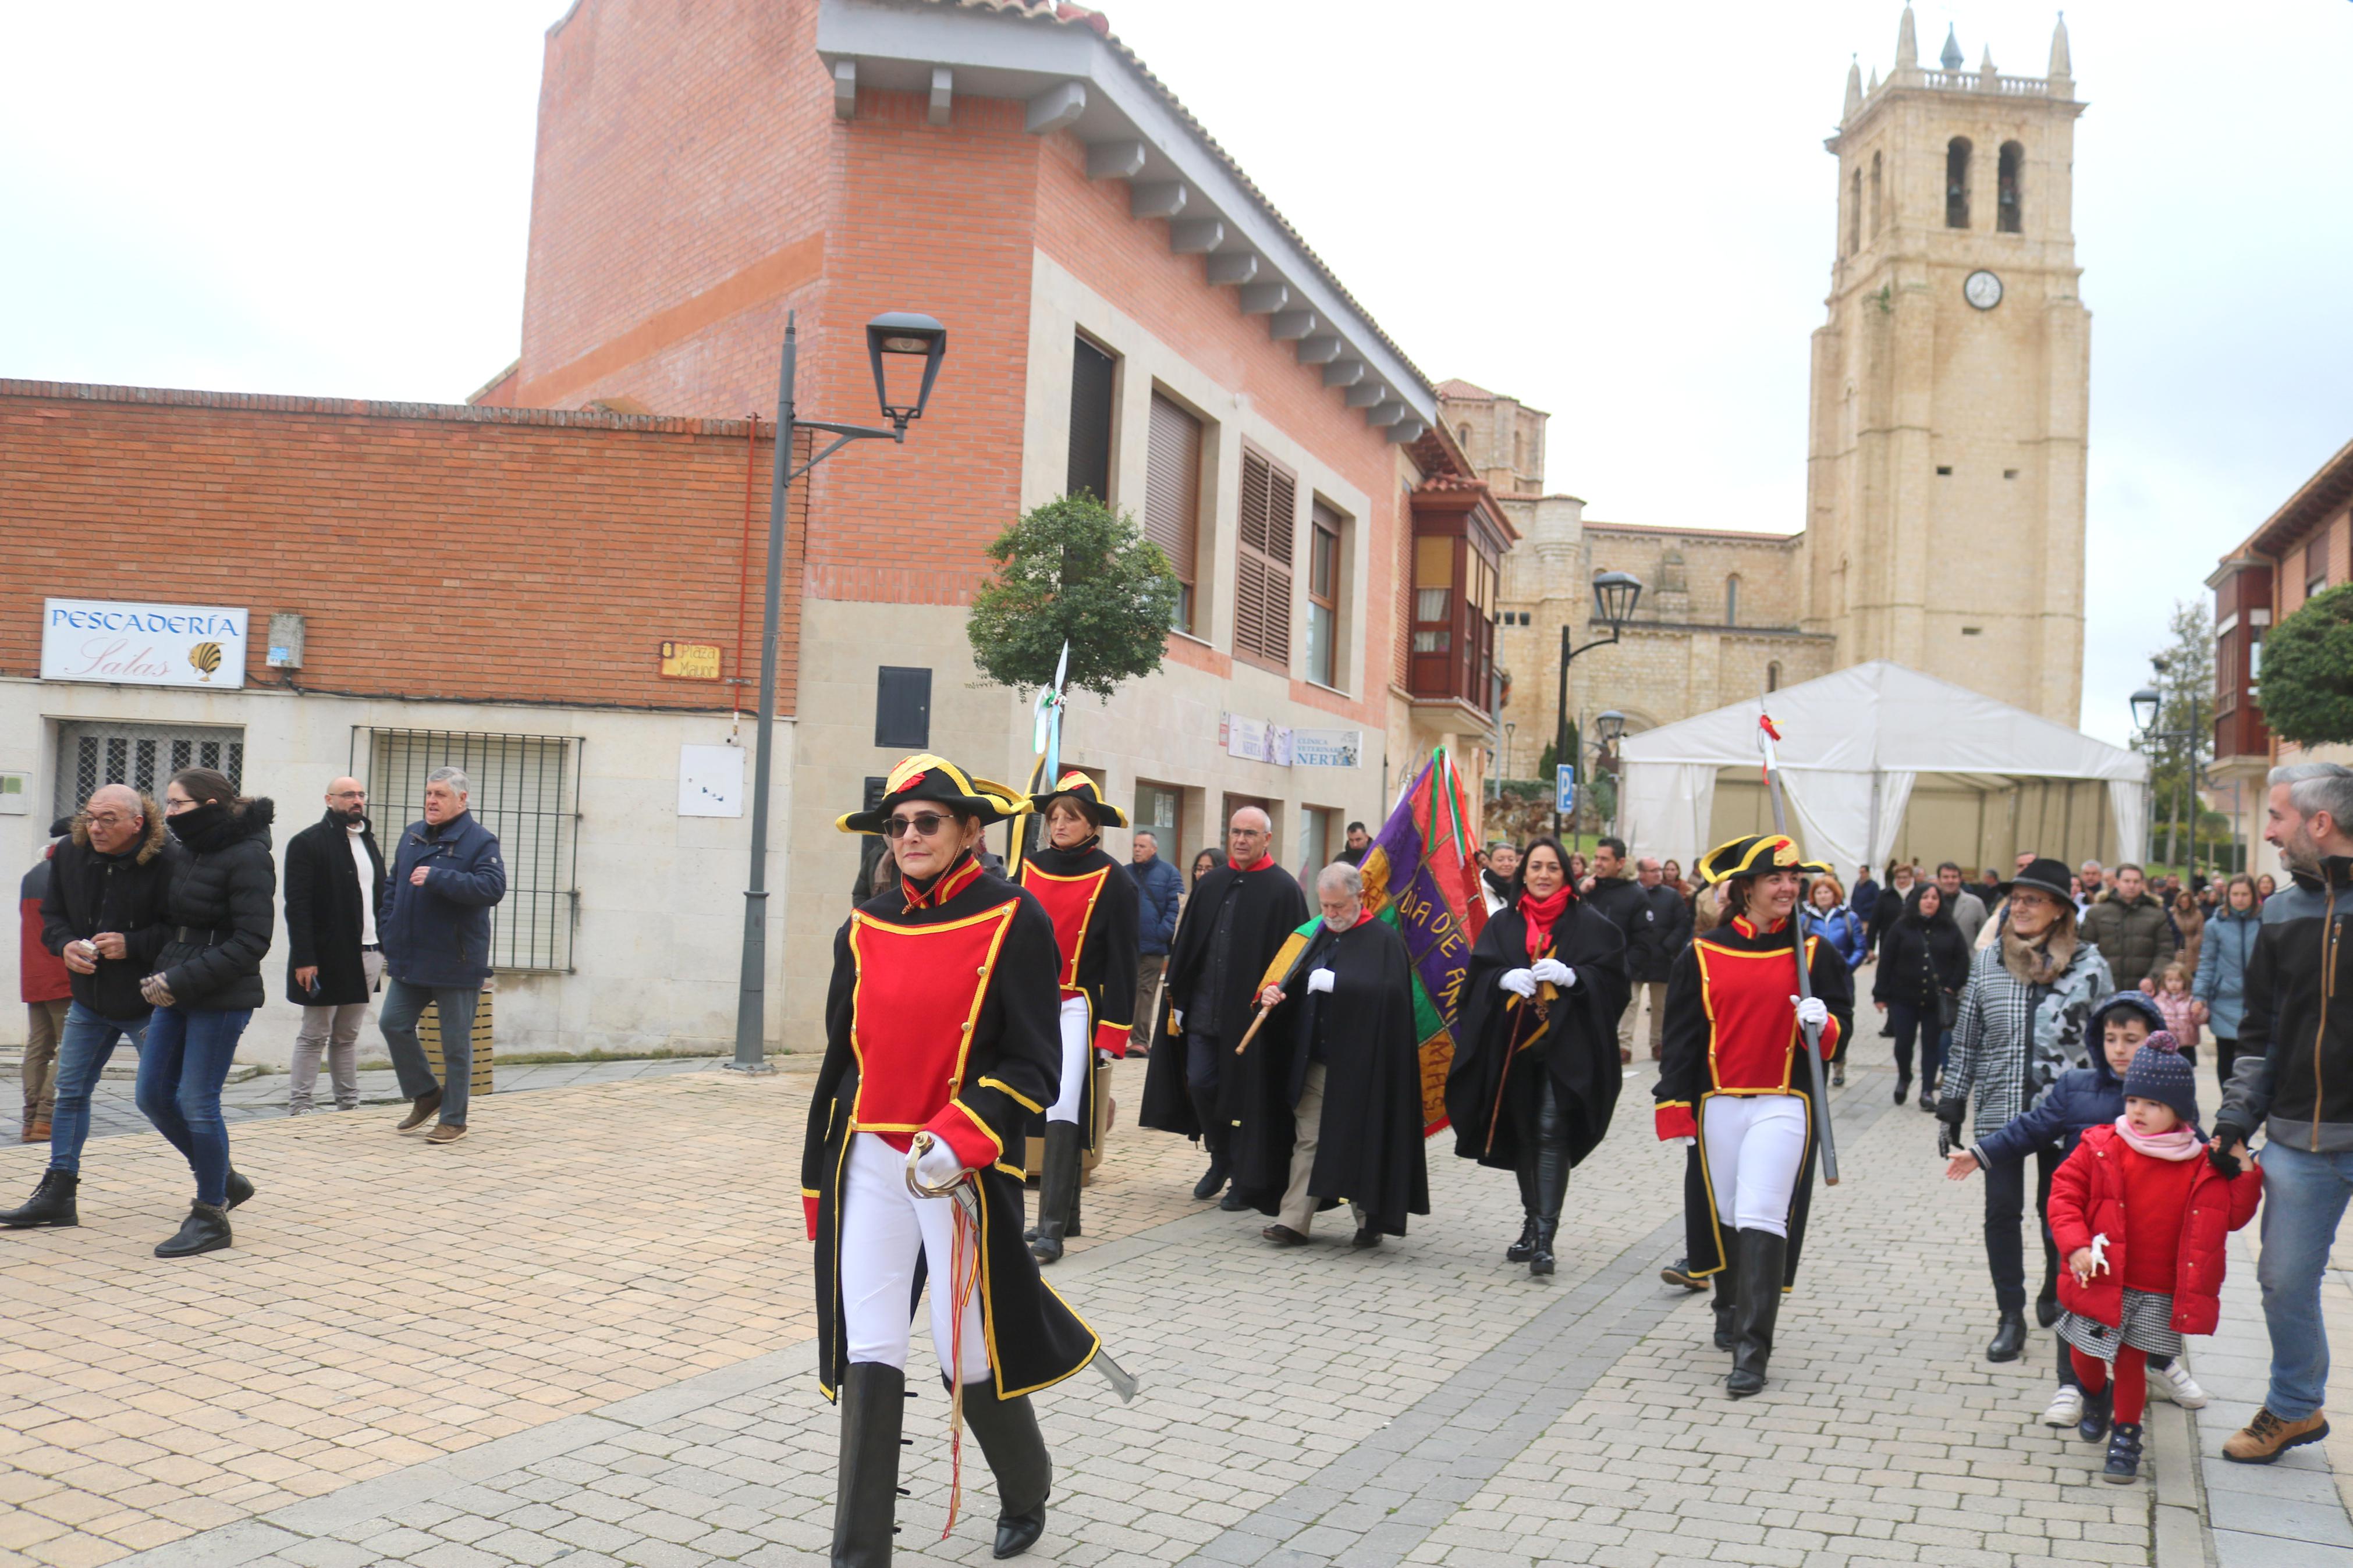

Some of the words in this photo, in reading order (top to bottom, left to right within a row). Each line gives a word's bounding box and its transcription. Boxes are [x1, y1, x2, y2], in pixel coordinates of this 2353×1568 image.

[52, 609, 240, 637] PESCADERÍA
[64, 637, 173, 677] Salas
[680, 644, 715, 659] Plaza
[1560, 771, 1571, 806] P
